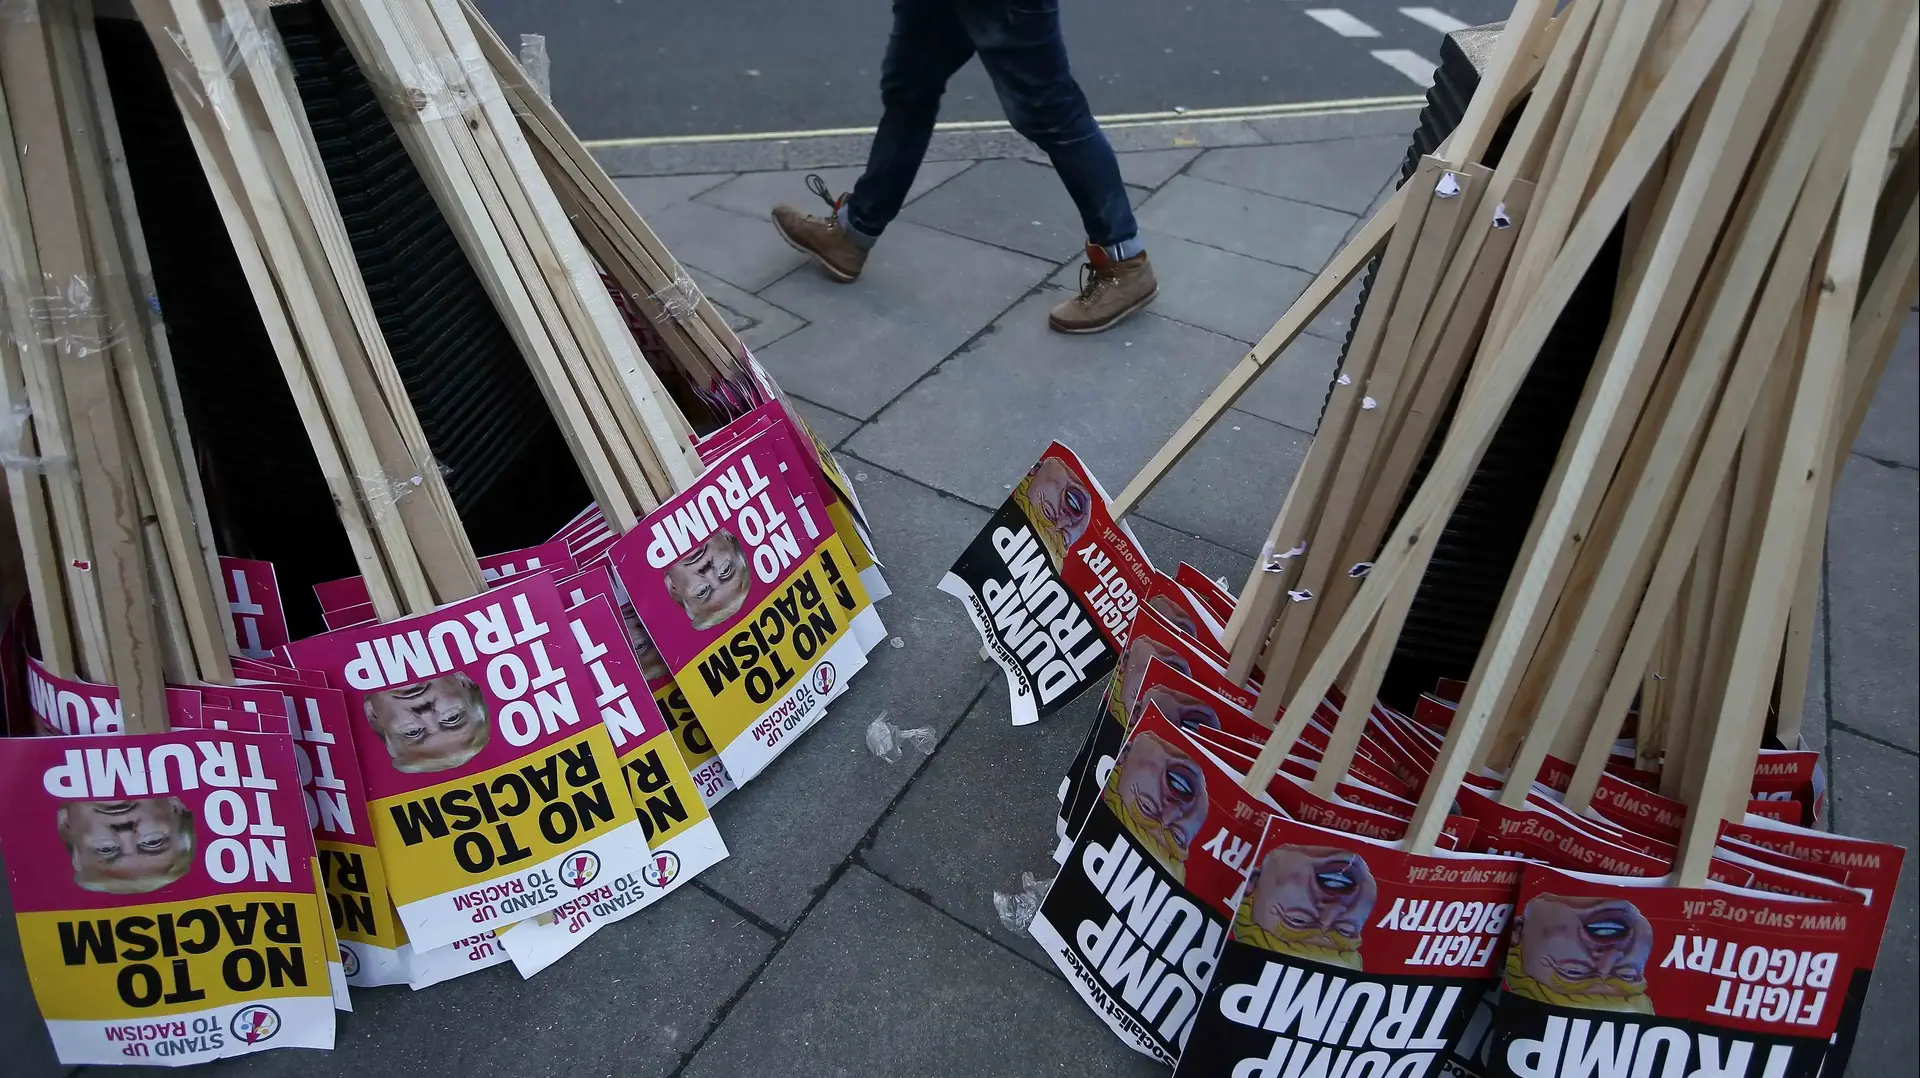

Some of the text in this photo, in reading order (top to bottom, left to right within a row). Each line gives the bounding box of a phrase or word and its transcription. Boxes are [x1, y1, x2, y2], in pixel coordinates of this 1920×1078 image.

[646, 453, 770, 569] TRUMP
[737, 491, 786, 547] TO
[753, 522, 802, 583] NO
[992, 525, 1107, 681] TRUMP
[1077, 542, 1141, 621] IGOTRY
[344, 593, 550, 691] TRUMP
[697, 569, 822, 698] RACISM
[792, 602, 838, 661] NO
[982, 578, 1080, 706] DUMP
[486, 639, 566, 701] TO
[744, 652, 795, 704] TO
[27, 663, 125, 736] RUM
[498, 681, 580, 747] NO
[751, 683, 811, 742] TO RACISM
[766, 694, 816, 748] STAND UP
[43, 741, 278, 798] TRUMP
[389, 739, 601, 847] RACISM
[692, 760, 723, 788] CISM
[705, 779, 724, 798] UP
[204, 790, 286, 837] TO
[453, 782, 616, 874] NO TO
[1297, 801, 1396, 841] .swp.org.uk
[204, 838, 292, 884] NO
[614, 872, 639, 892] TO
[452, 868, 553, 912] TO RACISM
[471, 883, 558, 924] STAND UP
[568, 886, 645, 934] STAND UP
[1083, 833, 1224, 996] RUMP
[1377, 897, 1515, 935] BIGOTRY
[1683, 900, 1847, 931] www.swp.org.uk
[57, 902, 302, 966] RACISM
[453, 930, 497, 950] CISM
[468, 941, 494, 962] UP
[1404, 934, 1496, 968] FIGHT
[1659, 934, 1839, 989] BIGOTRY
[117, 946, 308, 1009] NO TO
[1219, 960, 1463, 1050] TRUMP
[1705, 979, 1828, 1026] FIGHT
[104, 1014, 223, 1042] TO RACISM
[122, 1032, 225, 1057] STAND UP
